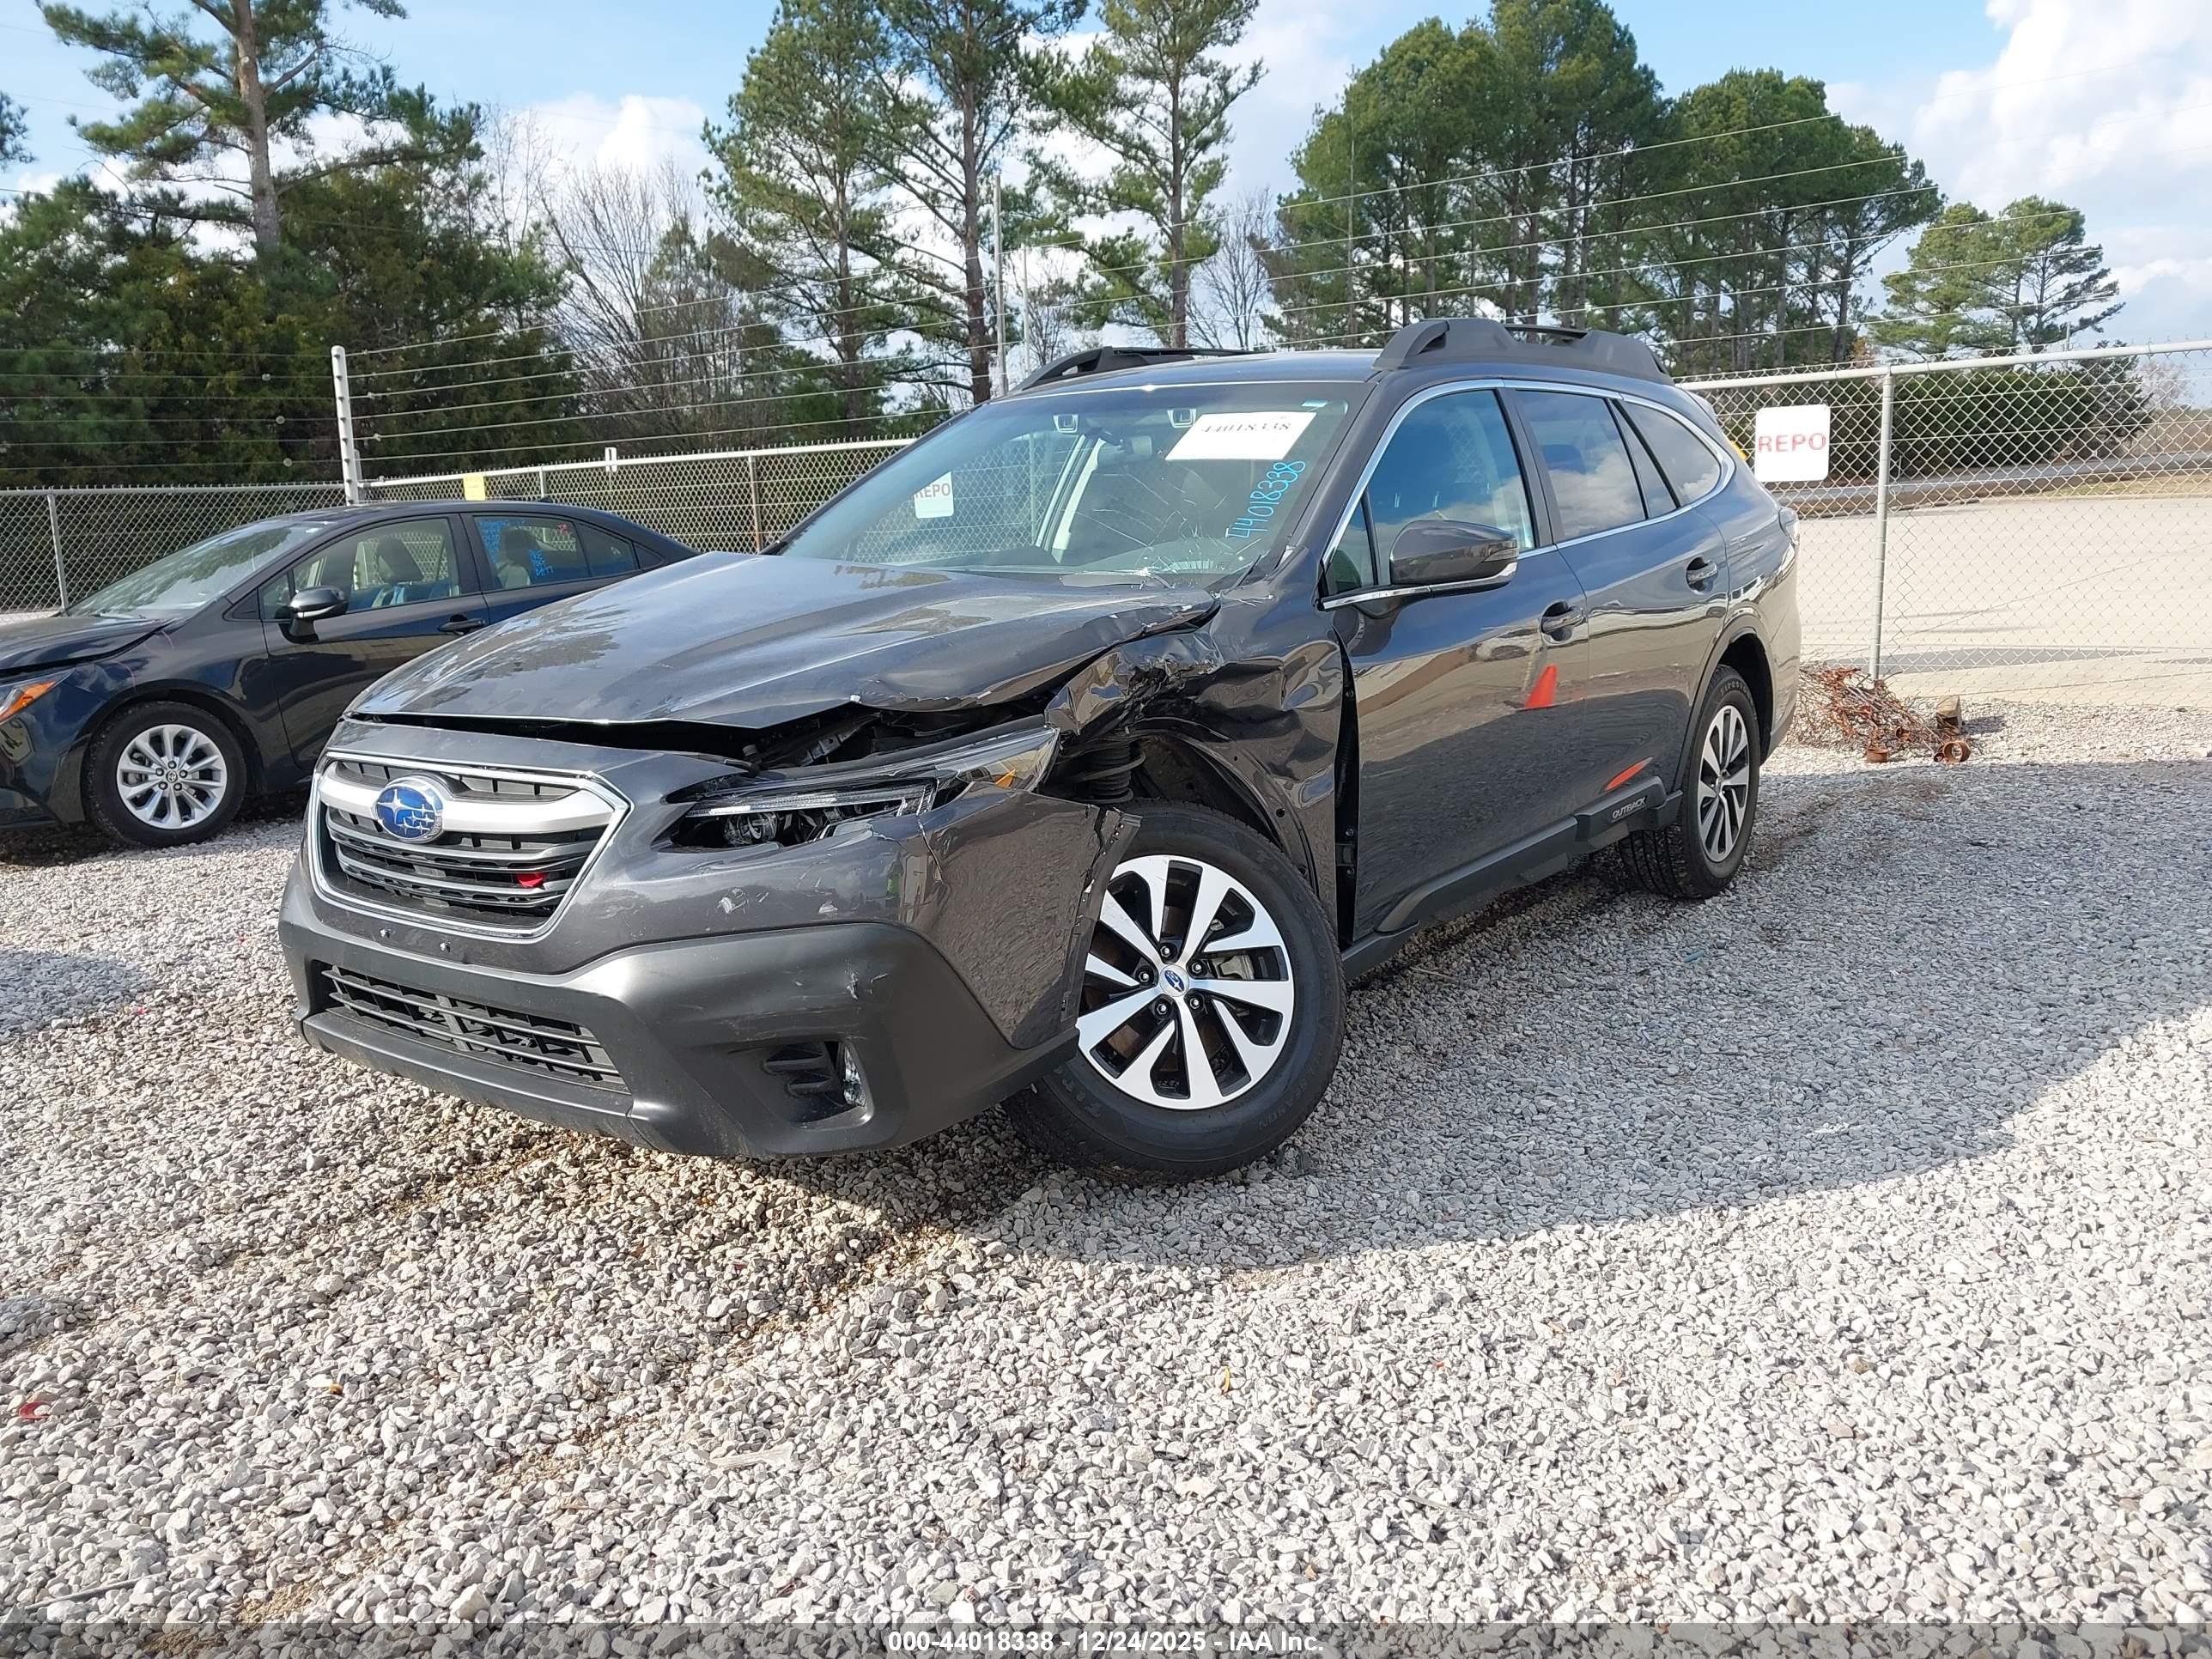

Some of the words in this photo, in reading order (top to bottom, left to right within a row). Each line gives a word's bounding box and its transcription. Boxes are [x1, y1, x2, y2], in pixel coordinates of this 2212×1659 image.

[1757, 432, 1827, 453] REPO
[1227, 460, 1306, 538] 44018338
[1613, 796, 1646, 818] OUTBACK
